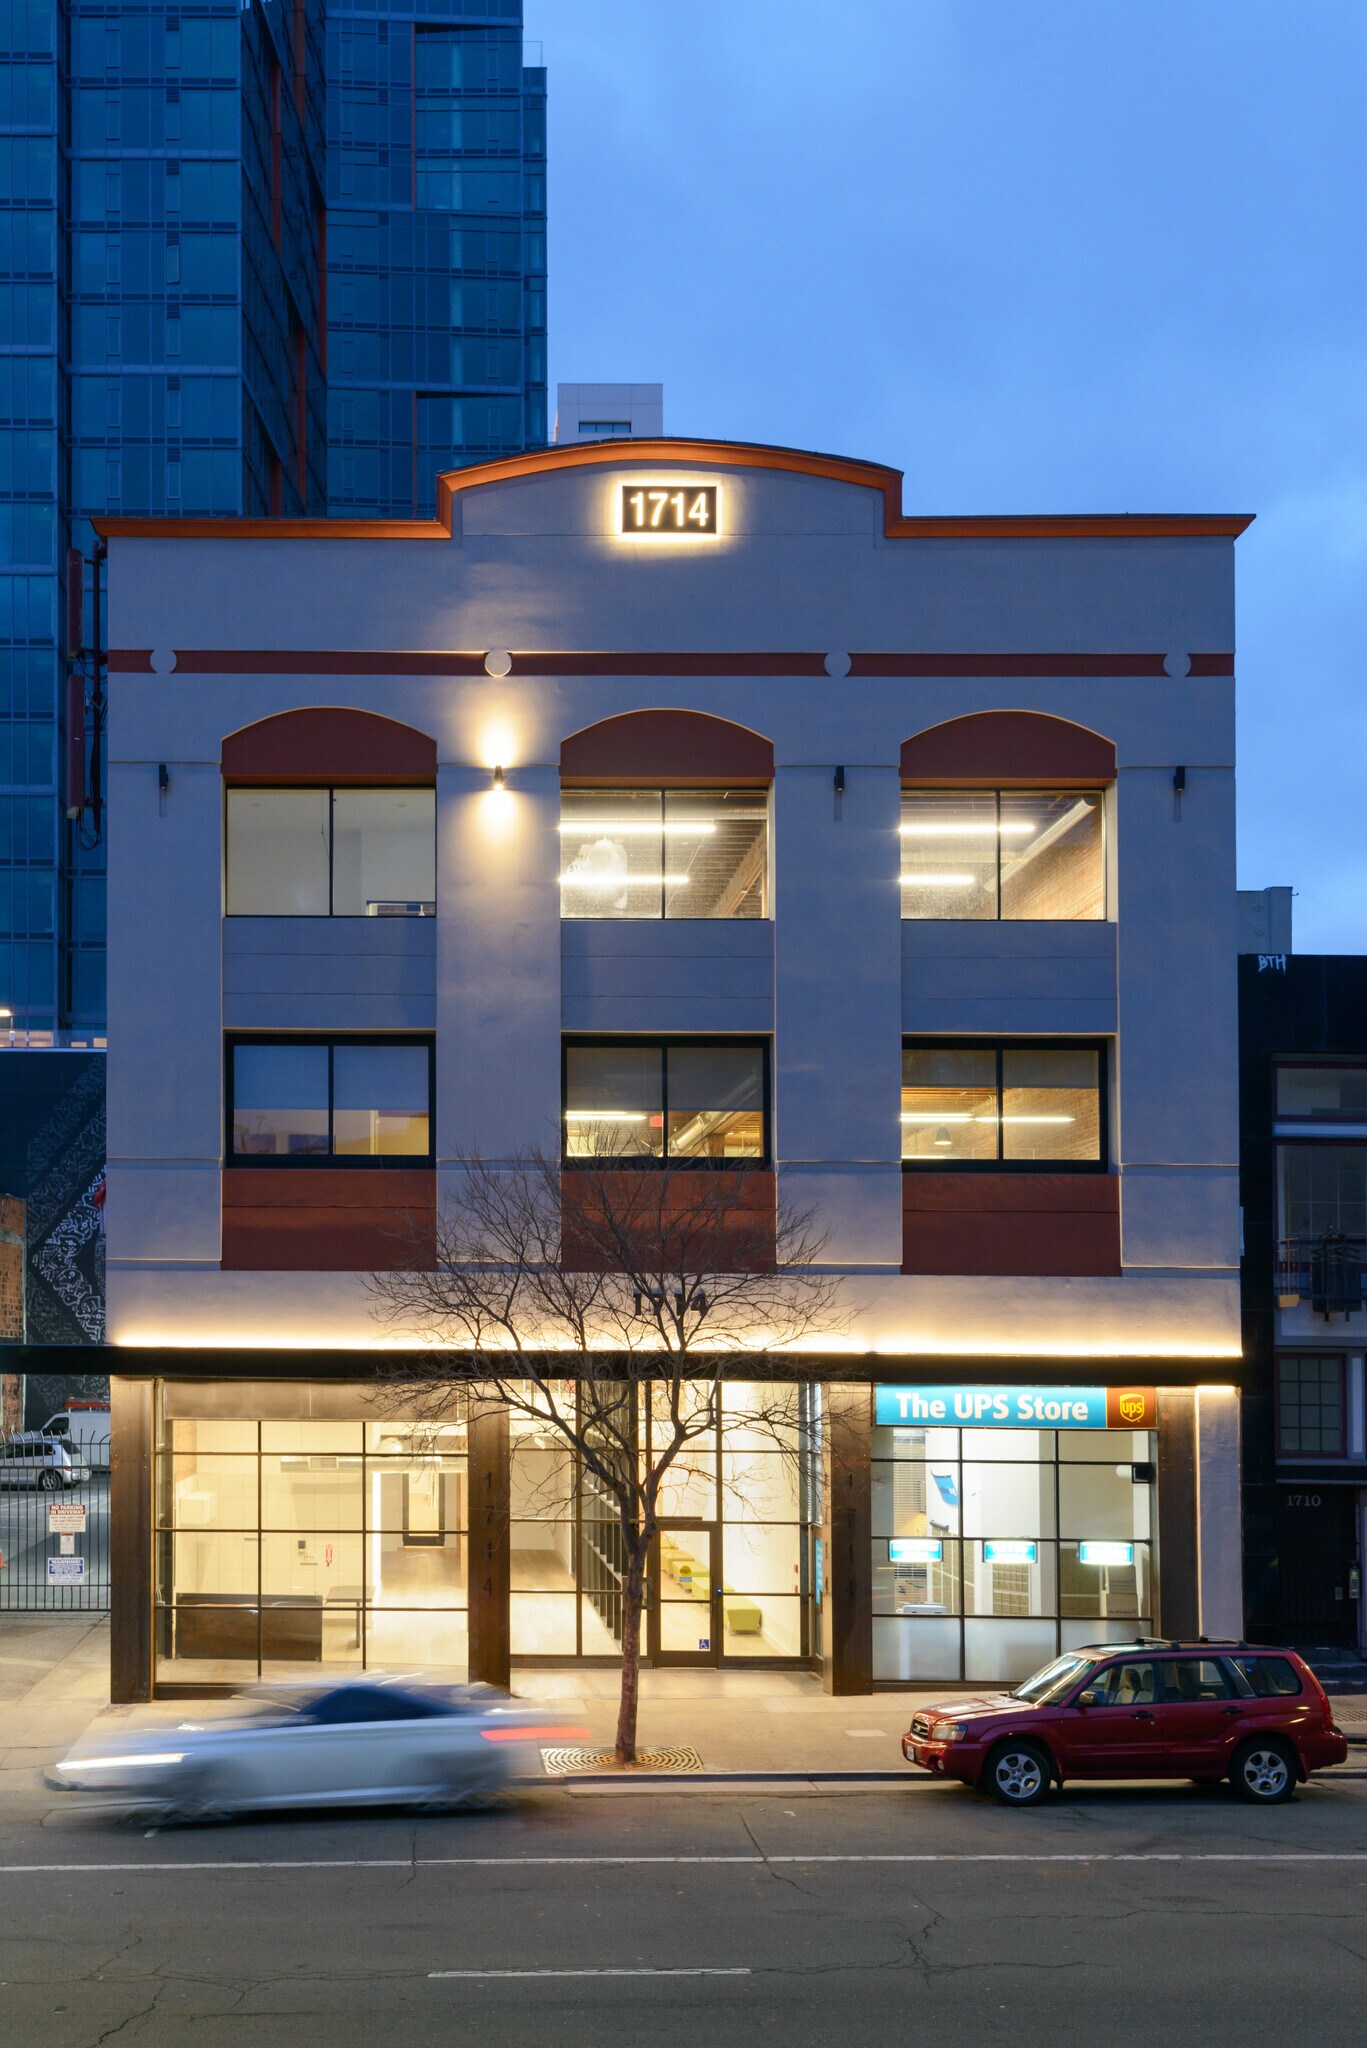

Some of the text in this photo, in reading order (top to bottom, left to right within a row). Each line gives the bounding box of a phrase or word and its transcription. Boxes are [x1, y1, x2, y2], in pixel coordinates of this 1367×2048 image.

[630, 491, 709, 527] 1714
[895, 1392, 1089, 1421] The UPS Store
[1122, 1402, 1143, 1418] ups
[1287, 1494, 1321, 1508] 1710
